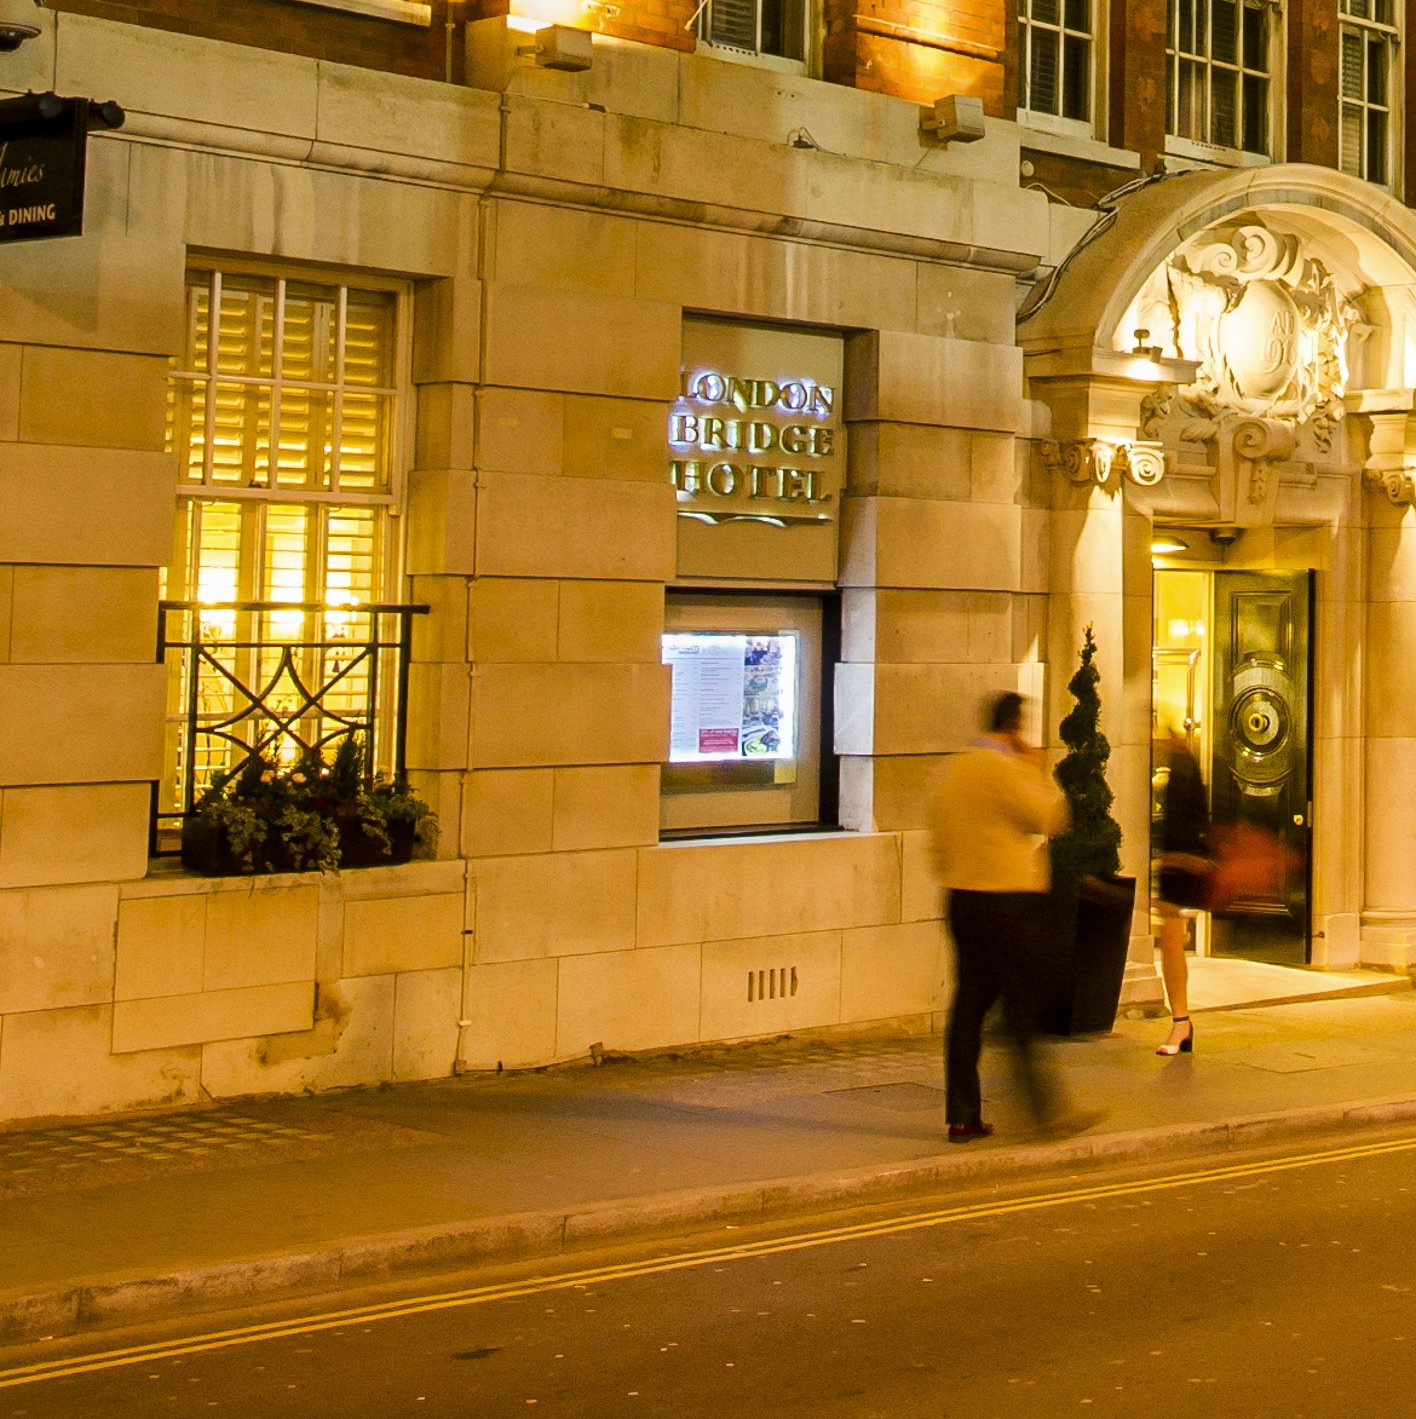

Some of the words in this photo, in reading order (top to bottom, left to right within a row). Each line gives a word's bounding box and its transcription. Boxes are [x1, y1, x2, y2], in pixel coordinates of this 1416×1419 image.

[8, 203, 56, 226] DINING
[679, 370, 837, 414] LONDON
[671, 414, 835, 457] BRIDGE
[669, 460, 833, 503] HOTEL
